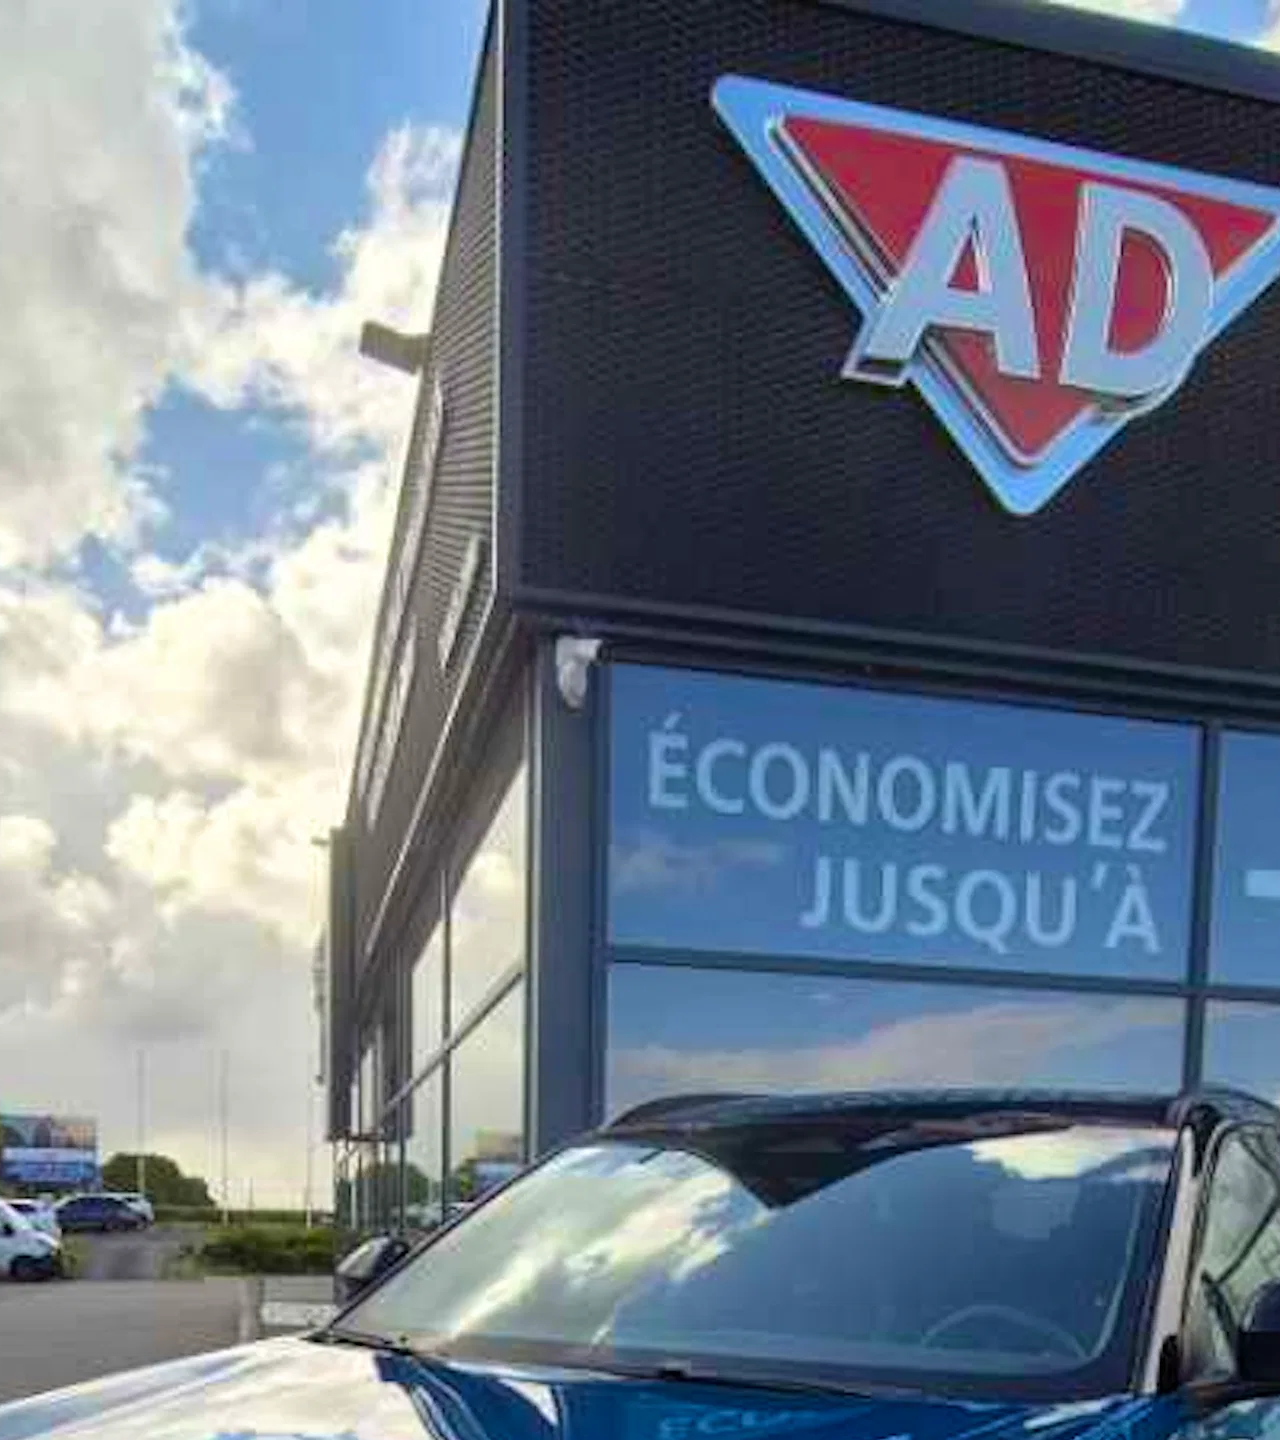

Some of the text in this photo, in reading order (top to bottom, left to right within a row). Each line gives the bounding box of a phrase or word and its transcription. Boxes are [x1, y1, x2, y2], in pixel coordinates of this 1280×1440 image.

[845, 153, 1216, 405] AD
[647, 713, 1170, 853] ÉCONOMISEZ
[798, 856, 1162, 955] JUSQU'À
